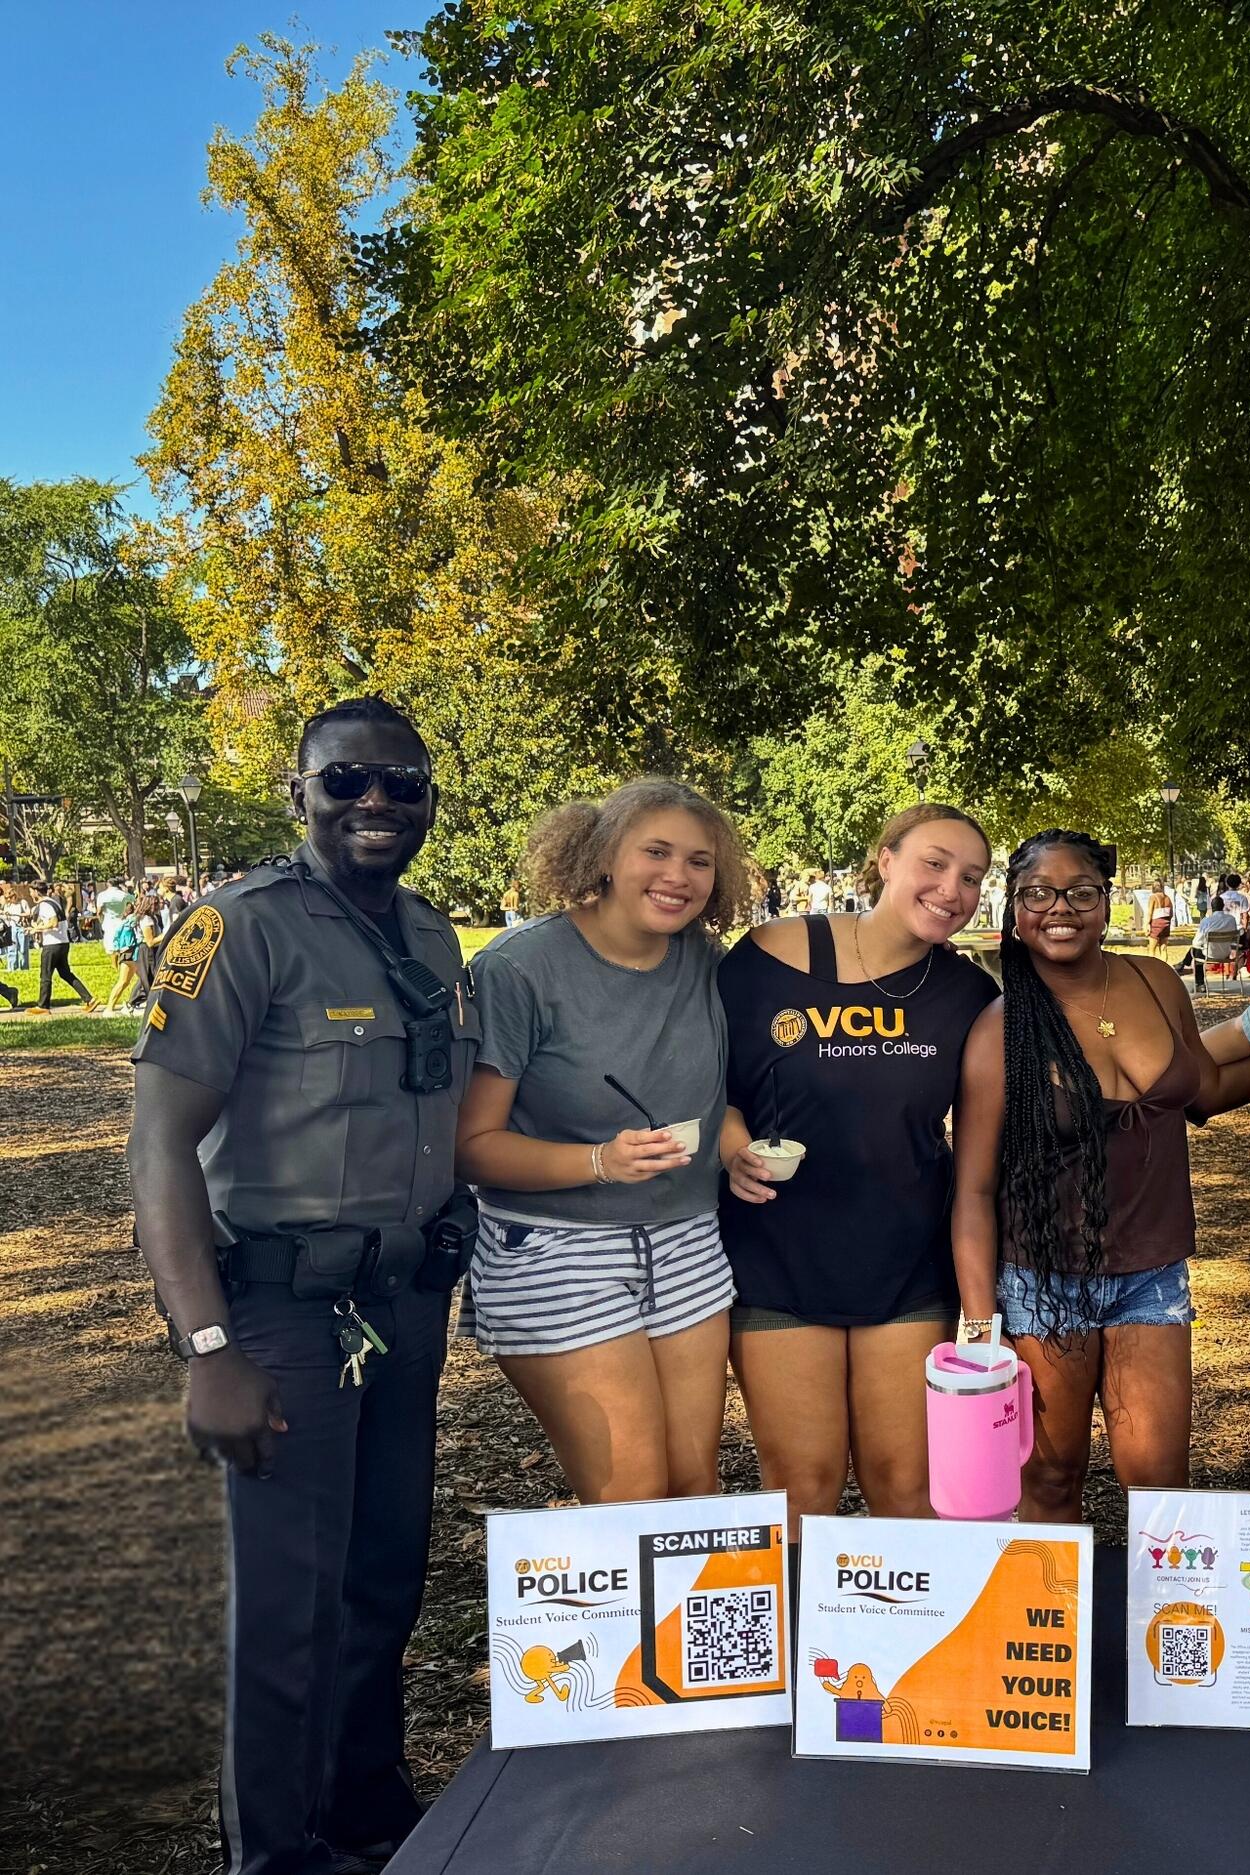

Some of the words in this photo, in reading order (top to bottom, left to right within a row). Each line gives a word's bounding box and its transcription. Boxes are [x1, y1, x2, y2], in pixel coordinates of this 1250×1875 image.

[806, 1006, 905, 1038] VCU
[818, 1044, 876, 1058] Honors
[882, 1041, 937, 1058] College
[652, 1532, 708, 1552] SCAN
[713, 1529, 760, 1547] HERE
[532, 1556, 571, 1572] VCU
[850, 1555, 882, 1568] VCU
[518, 1568, 628, 1598] POLICE
[837, 1569, 930, 1592] POLICE
[496, 1614, 542, 1628] Student
[546, 1611, 578, 1623] Voice
[818, 1603, 856, 1614] Student
[859, 1605, 886, 1615] Voice
[889, 1606, 945, 1617] Committee
[1026, 1608, 1065, 1628] WE
[1153, 1603, 1189, 1615] SCAN
[1195, 1604, 1217, 1616] ME!
[1006, 1642, 1072, 1663] NEED
[1002, 1676, 1072, 1698] YOUR
[986, 1709, 1071, 1732] VOICE!
